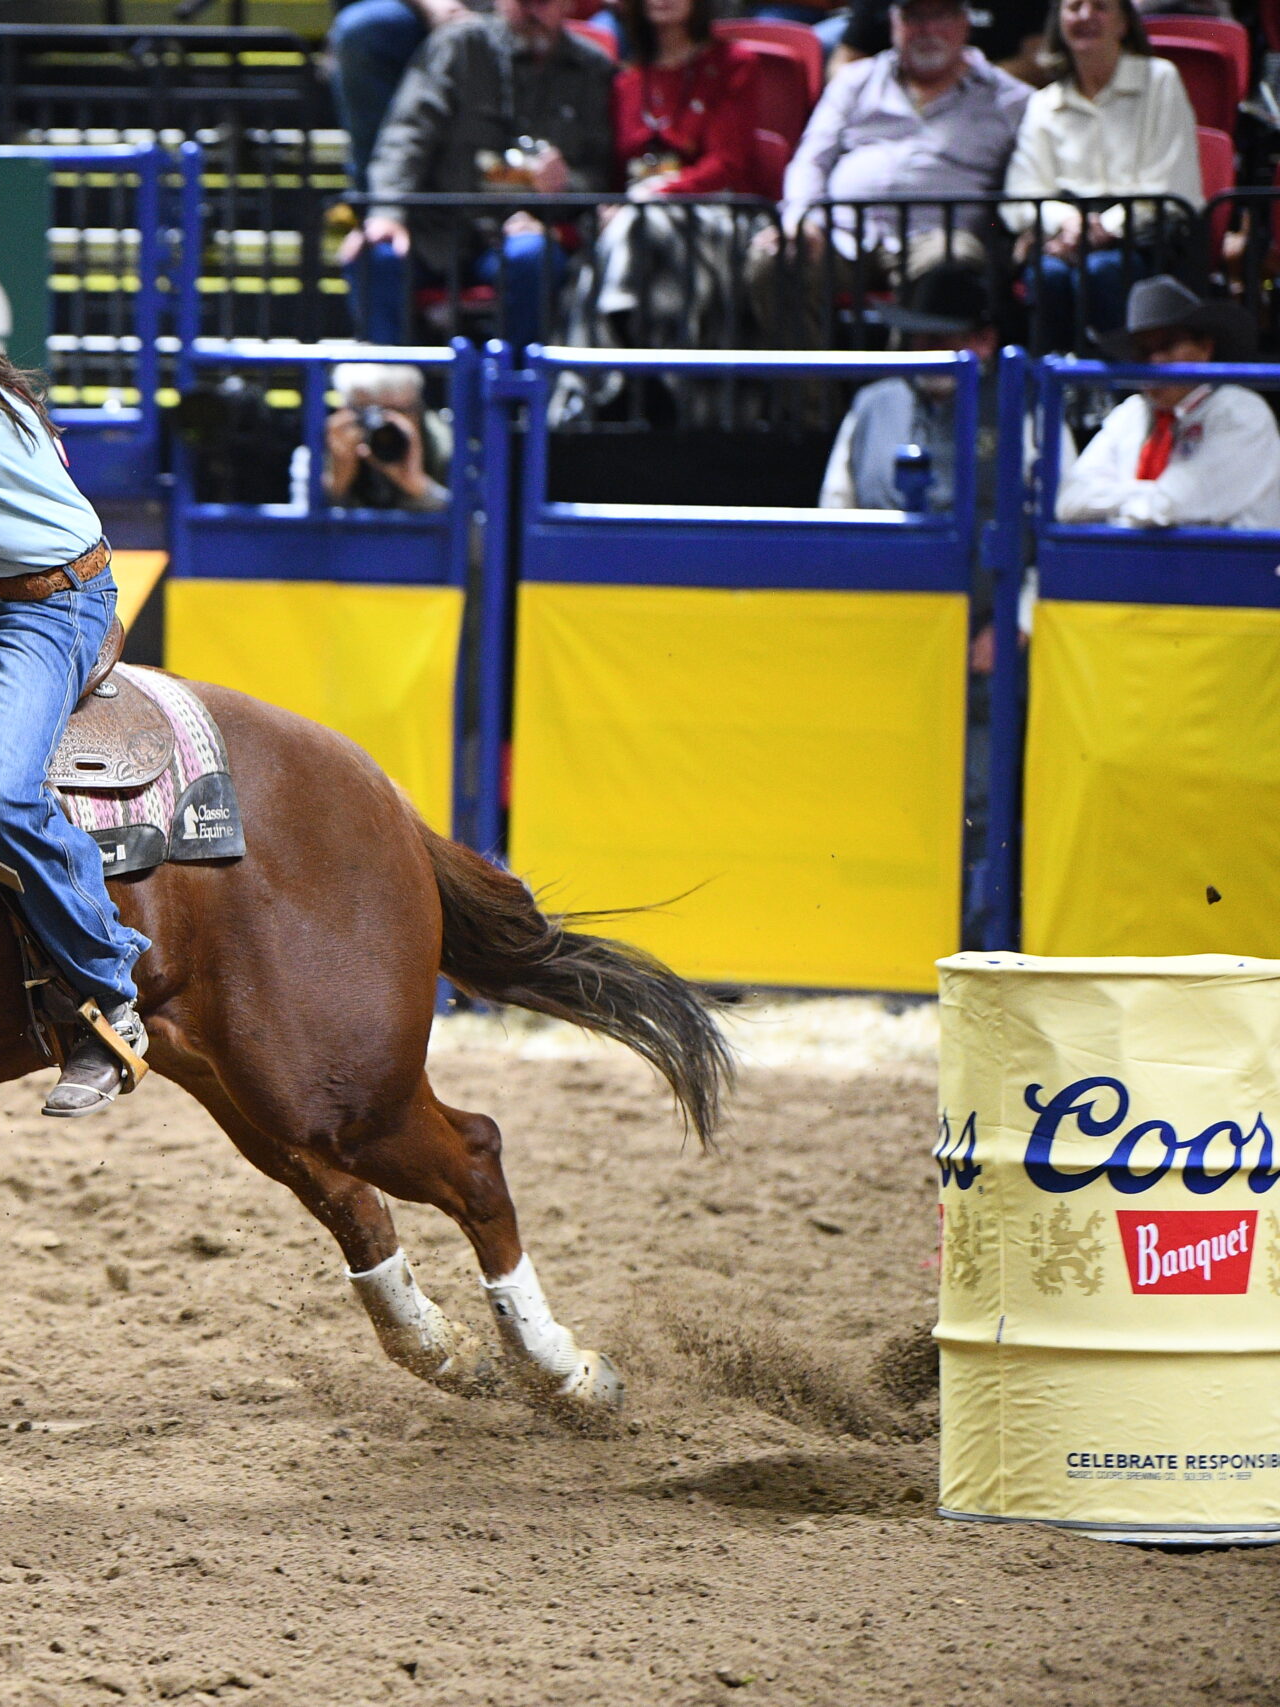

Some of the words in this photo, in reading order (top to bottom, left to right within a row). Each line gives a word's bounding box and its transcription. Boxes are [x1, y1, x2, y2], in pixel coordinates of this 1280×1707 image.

[198, 804, 230, 821] Classic
[199, 823, 234, 842] Equine
[1135, 1219, 1250, 1286] Banquet
[1066, 1452, 1178, 1469] CELEBRATE
